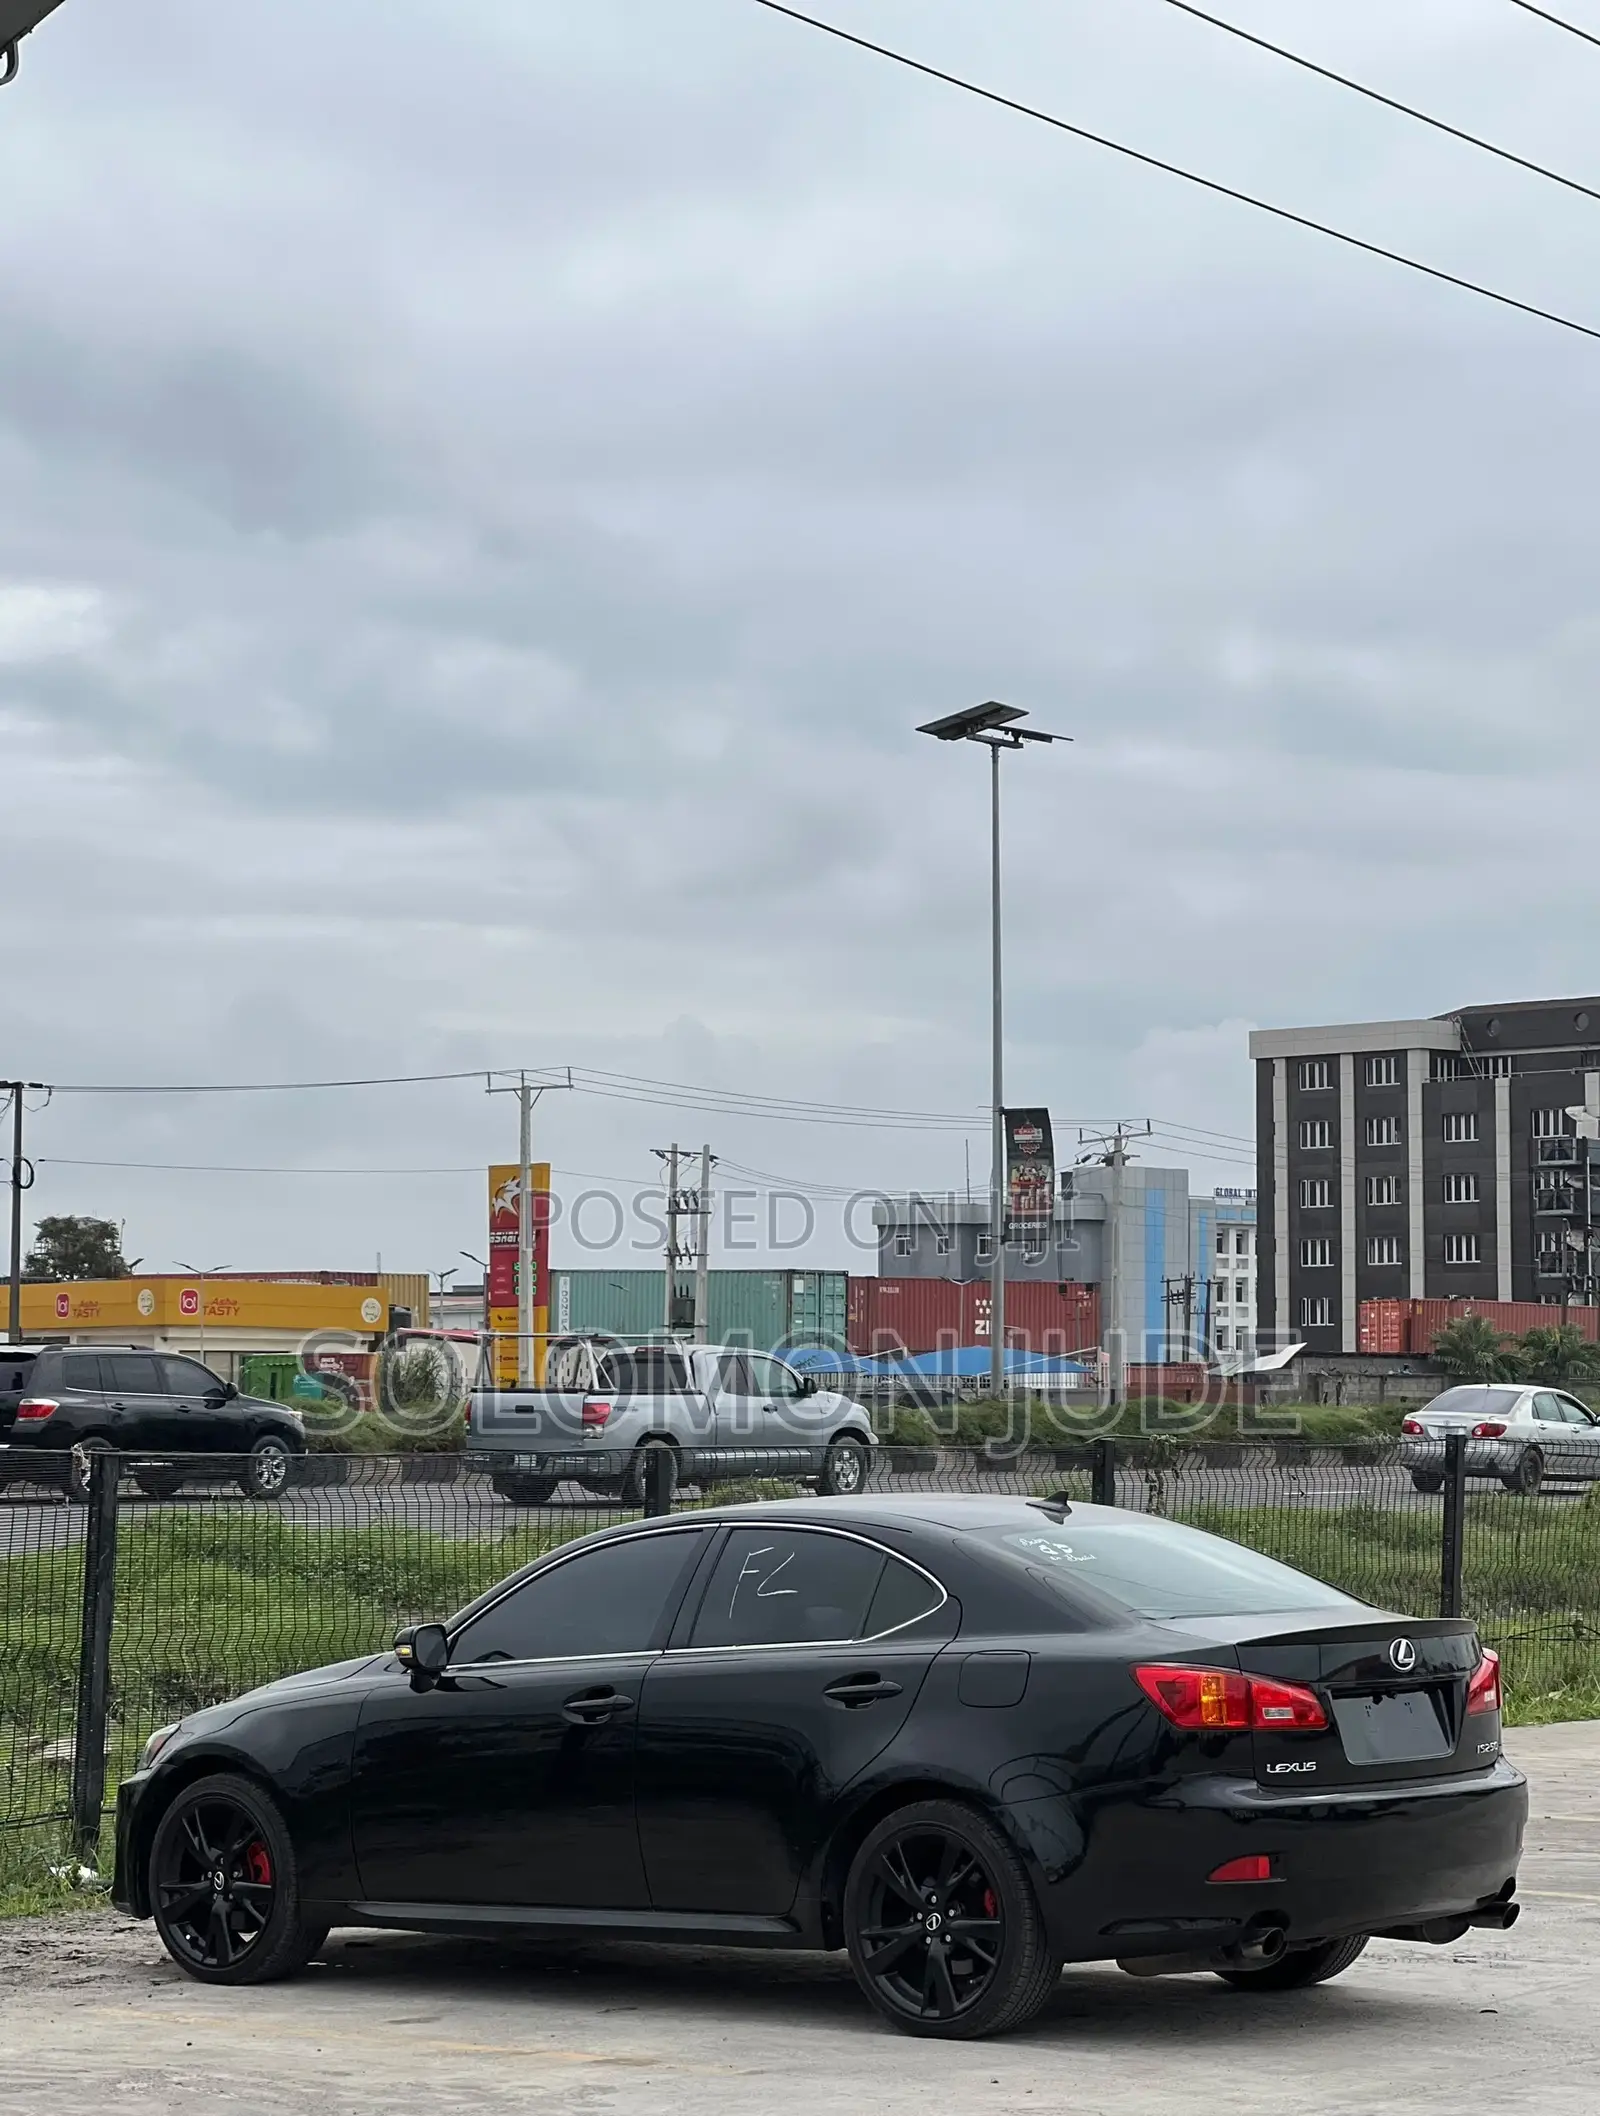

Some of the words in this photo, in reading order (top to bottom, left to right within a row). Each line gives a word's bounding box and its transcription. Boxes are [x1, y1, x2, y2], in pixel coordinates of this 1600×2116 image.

[1215, 1187, 1242, 1198] GLOBAL
[1008, 1221, 1048, 1230] GROCERIES
[72, 1308, 101, 1318] TASTY
[202, 1306, 240, 1316] TASTY
[974, 1319, 993, 1335] ZI
[1266, 1761, 1317, 1774] LEXUS
